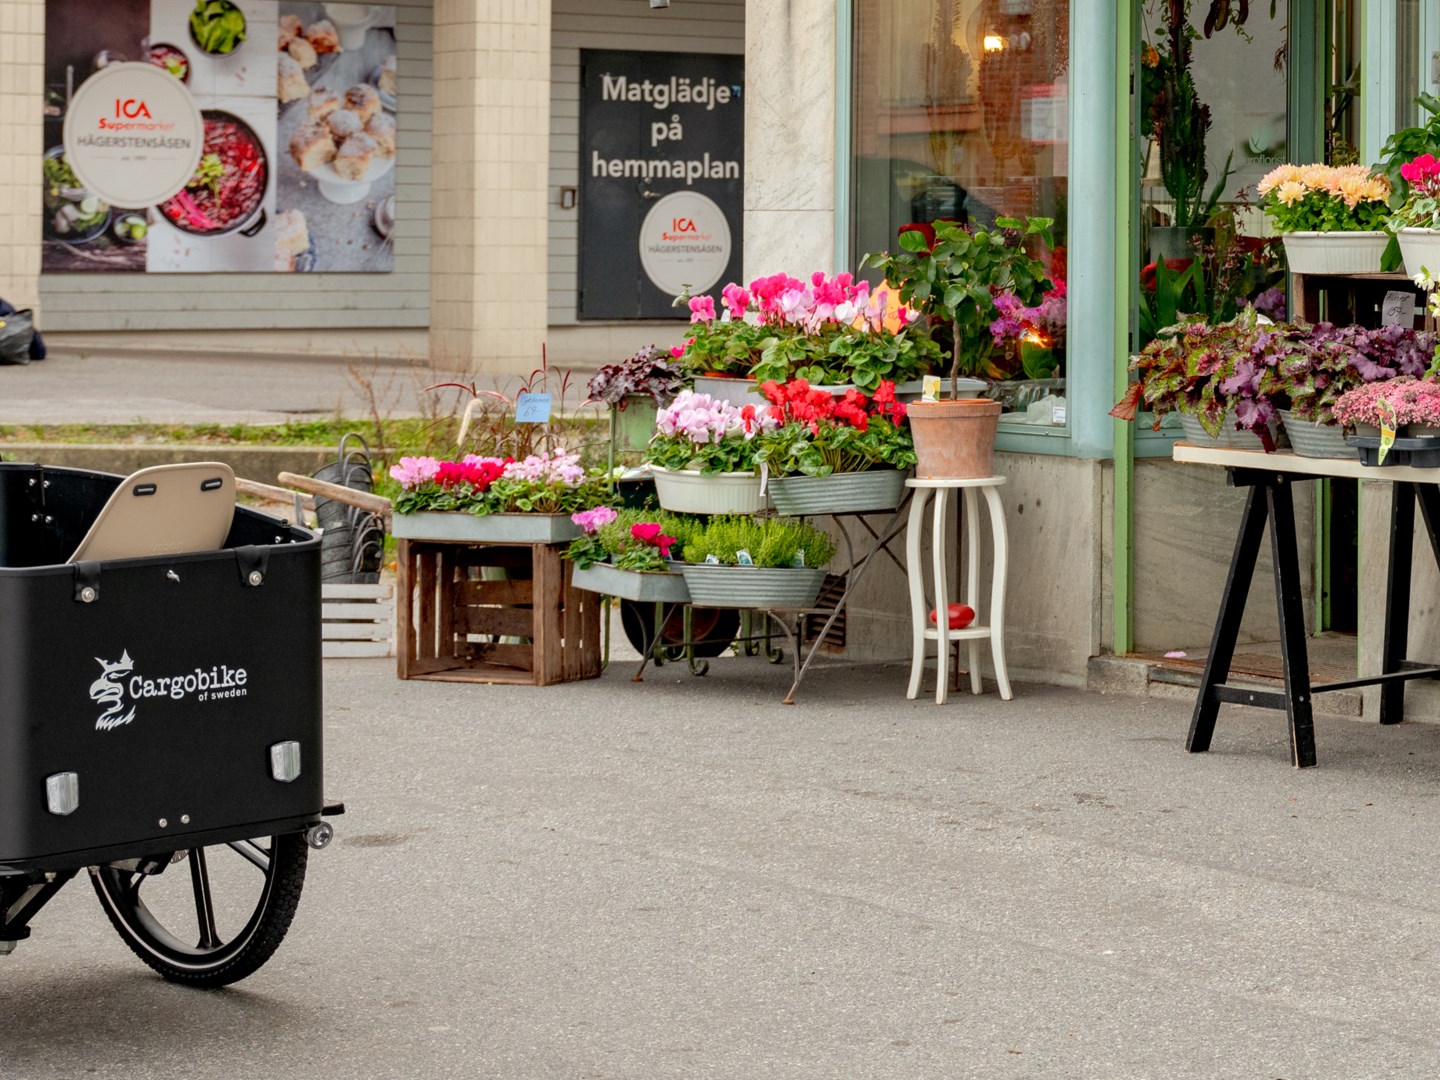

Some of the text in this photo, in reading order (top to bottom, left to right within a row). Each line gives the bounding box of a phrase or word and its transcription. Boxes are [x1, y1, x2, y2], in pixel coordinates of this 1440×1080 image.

[115, 98, 152, 119] ICA
[602, 76, 732, 110] Matglädje
[651, 114, 682, 147] på
[592, 150, 739, 185] hemmaplan
[672, 218, 697, 232] ICA
[129, 665, 248, 699] Cargobike
[198, 688, 247, 702] of sweden
